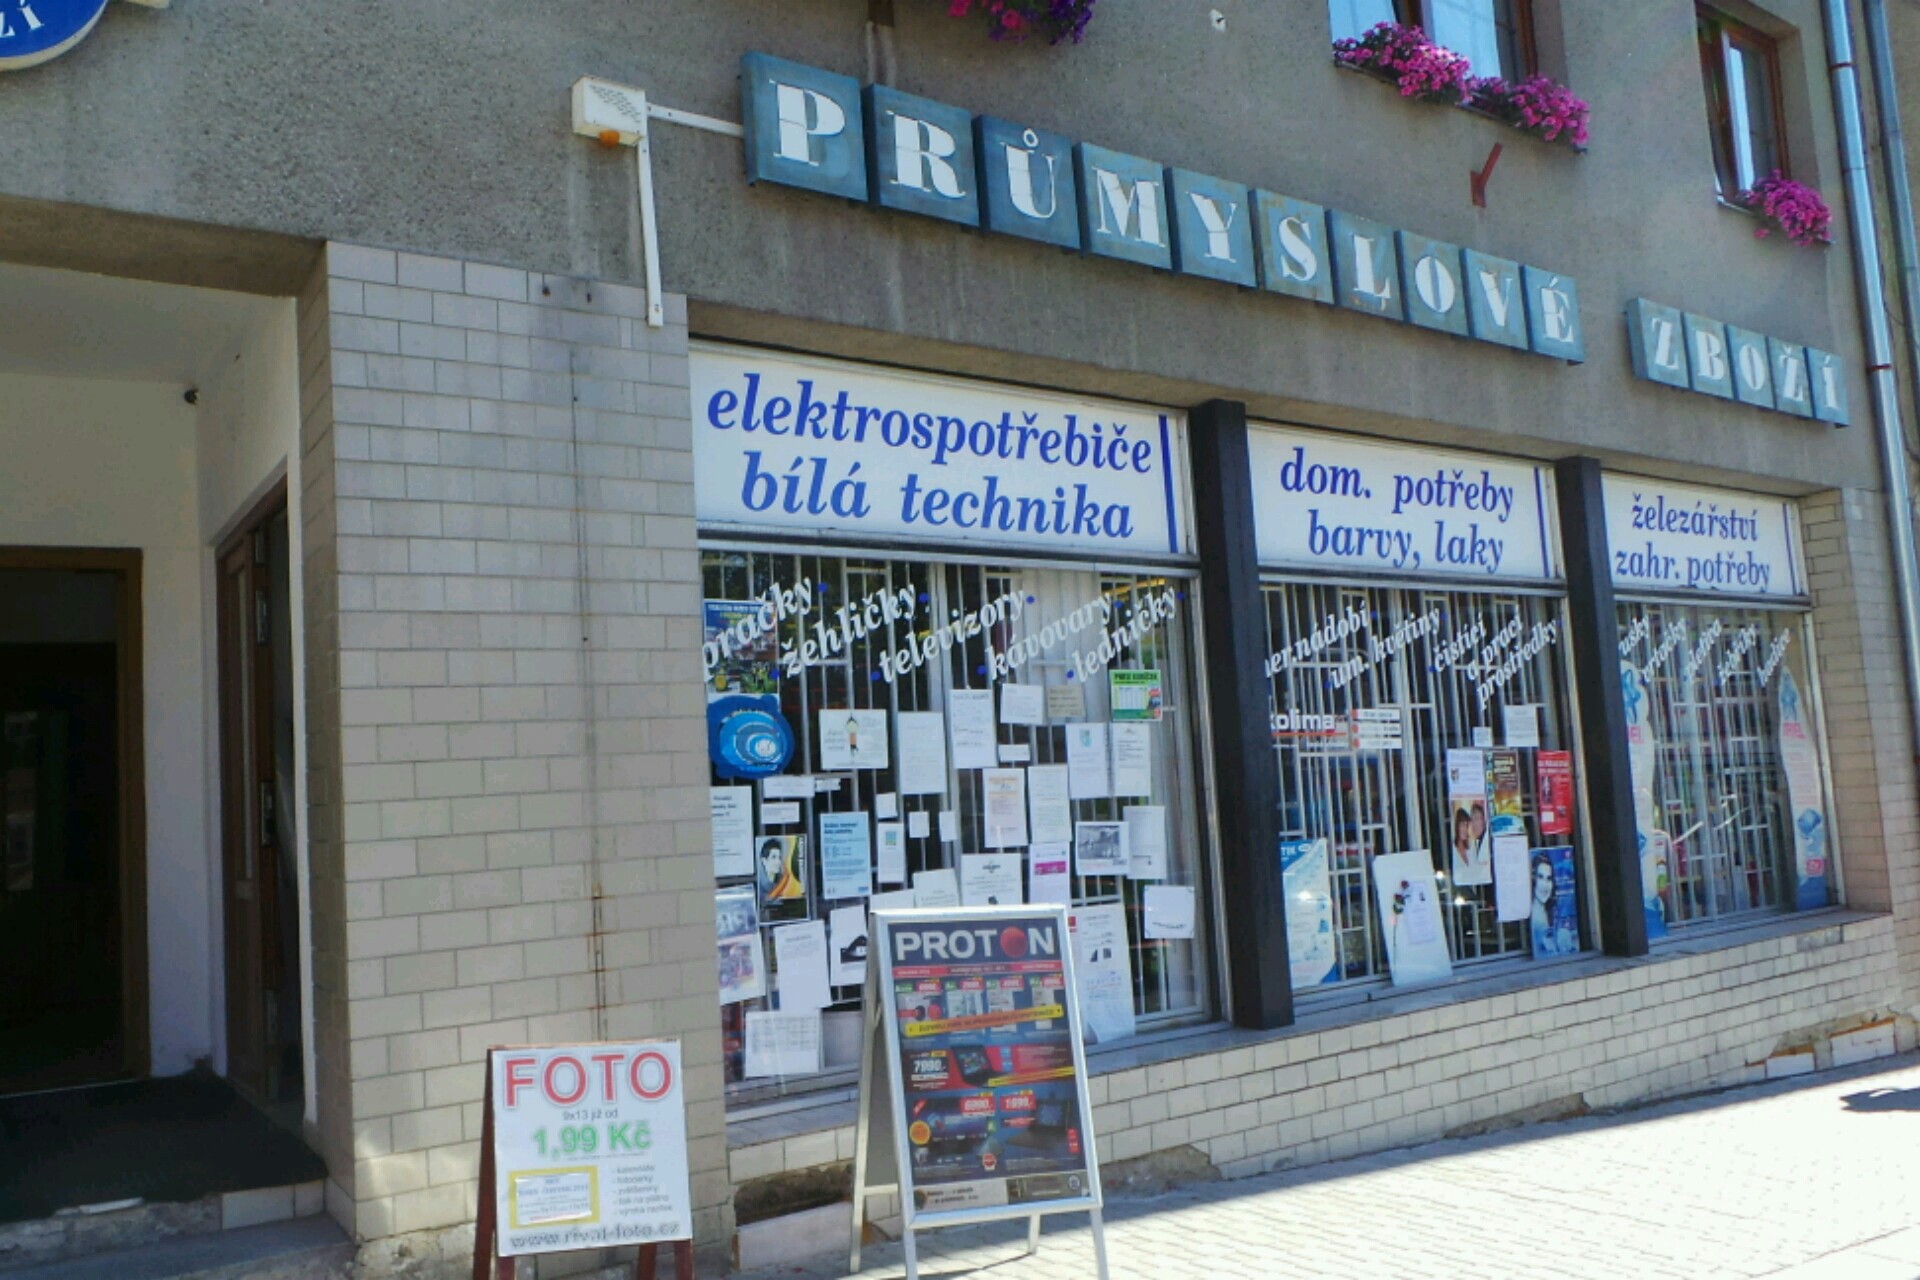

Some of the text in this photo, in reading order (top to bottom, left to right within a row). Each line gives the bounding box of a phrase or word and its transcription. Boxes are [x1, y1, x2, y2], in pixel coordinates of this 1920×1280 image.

[769, 79, 1840, 410] PRŮMYSLOVÉ ZBOŽÍ
[707, 372, 1152, 474] elektrospotřebiče
[741, 449, 1134, 539] bílá technika
[1280, 446, 1514, 523] dom. potřeby
[1631, 492, 1759, 543] železářství
[1307, 508, 1503, 574] barvy, laky
[1614, 543, 1771, 593] zahr. potřeby
[703, 577, 812, 683] pračky
[781, 583, 916, 679] žehličky
[879, 589, 1025, 684] televizory
[985, 591, 1112, 681] kávovary
[1072, 586, 1177, 683] ledničky
[1295, 599, 1369, 661] nádobí
[1370, 607, 1440, 663] květiny
[894, 925, 1056, 962] PROTON
[504, 1050, 673, 1108] FOTO
[532, 1119, 652, 1161] 1,99 Kč
